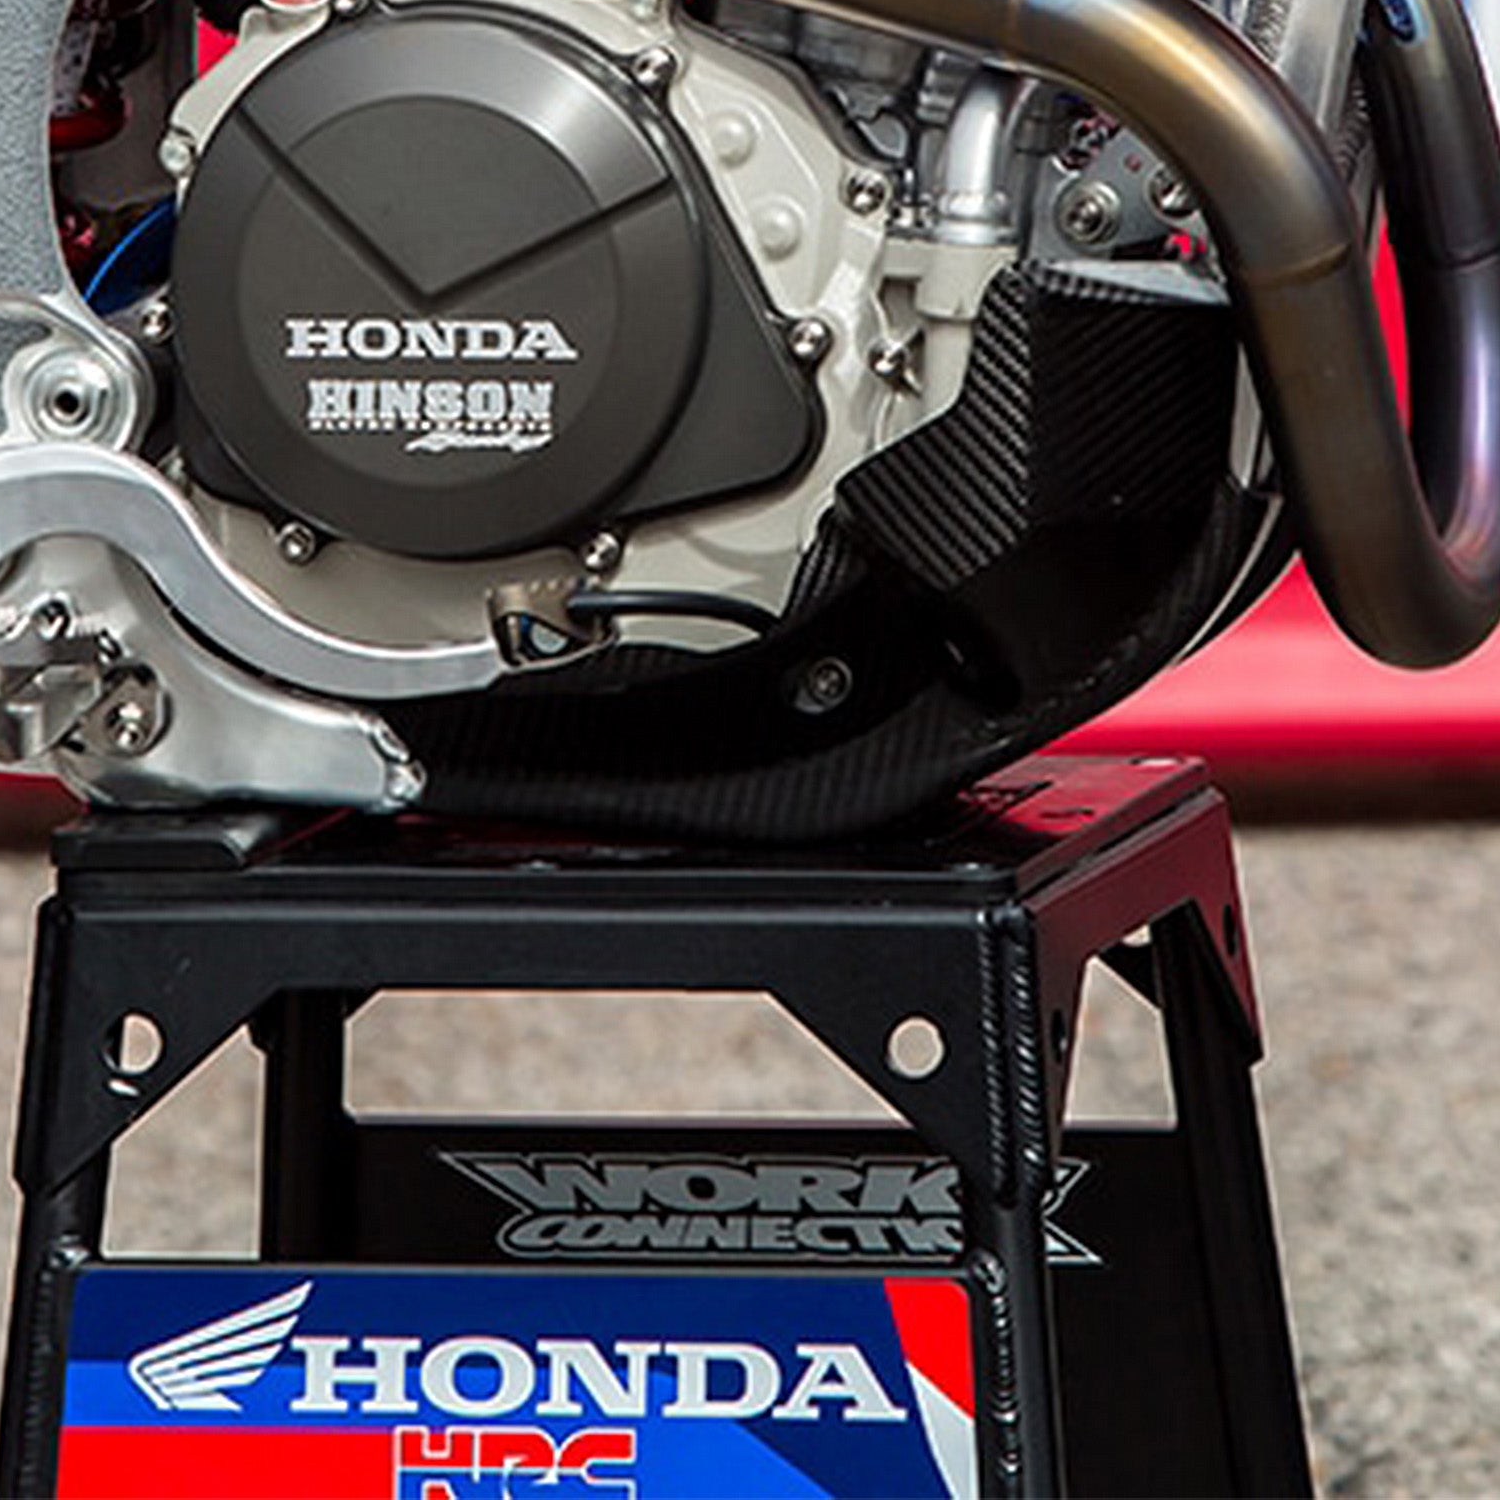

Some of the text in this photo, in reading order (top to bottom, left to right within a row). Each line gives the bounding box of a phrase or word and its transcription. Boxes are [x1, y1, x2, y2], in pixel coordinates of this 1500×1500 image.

[285, 319, 579, 359] HONDA
[307, 380, 553, 419] HINSON
[475, 1162, 962, 1214] WORK
[290, 1337, 907, 1421] HONDA
